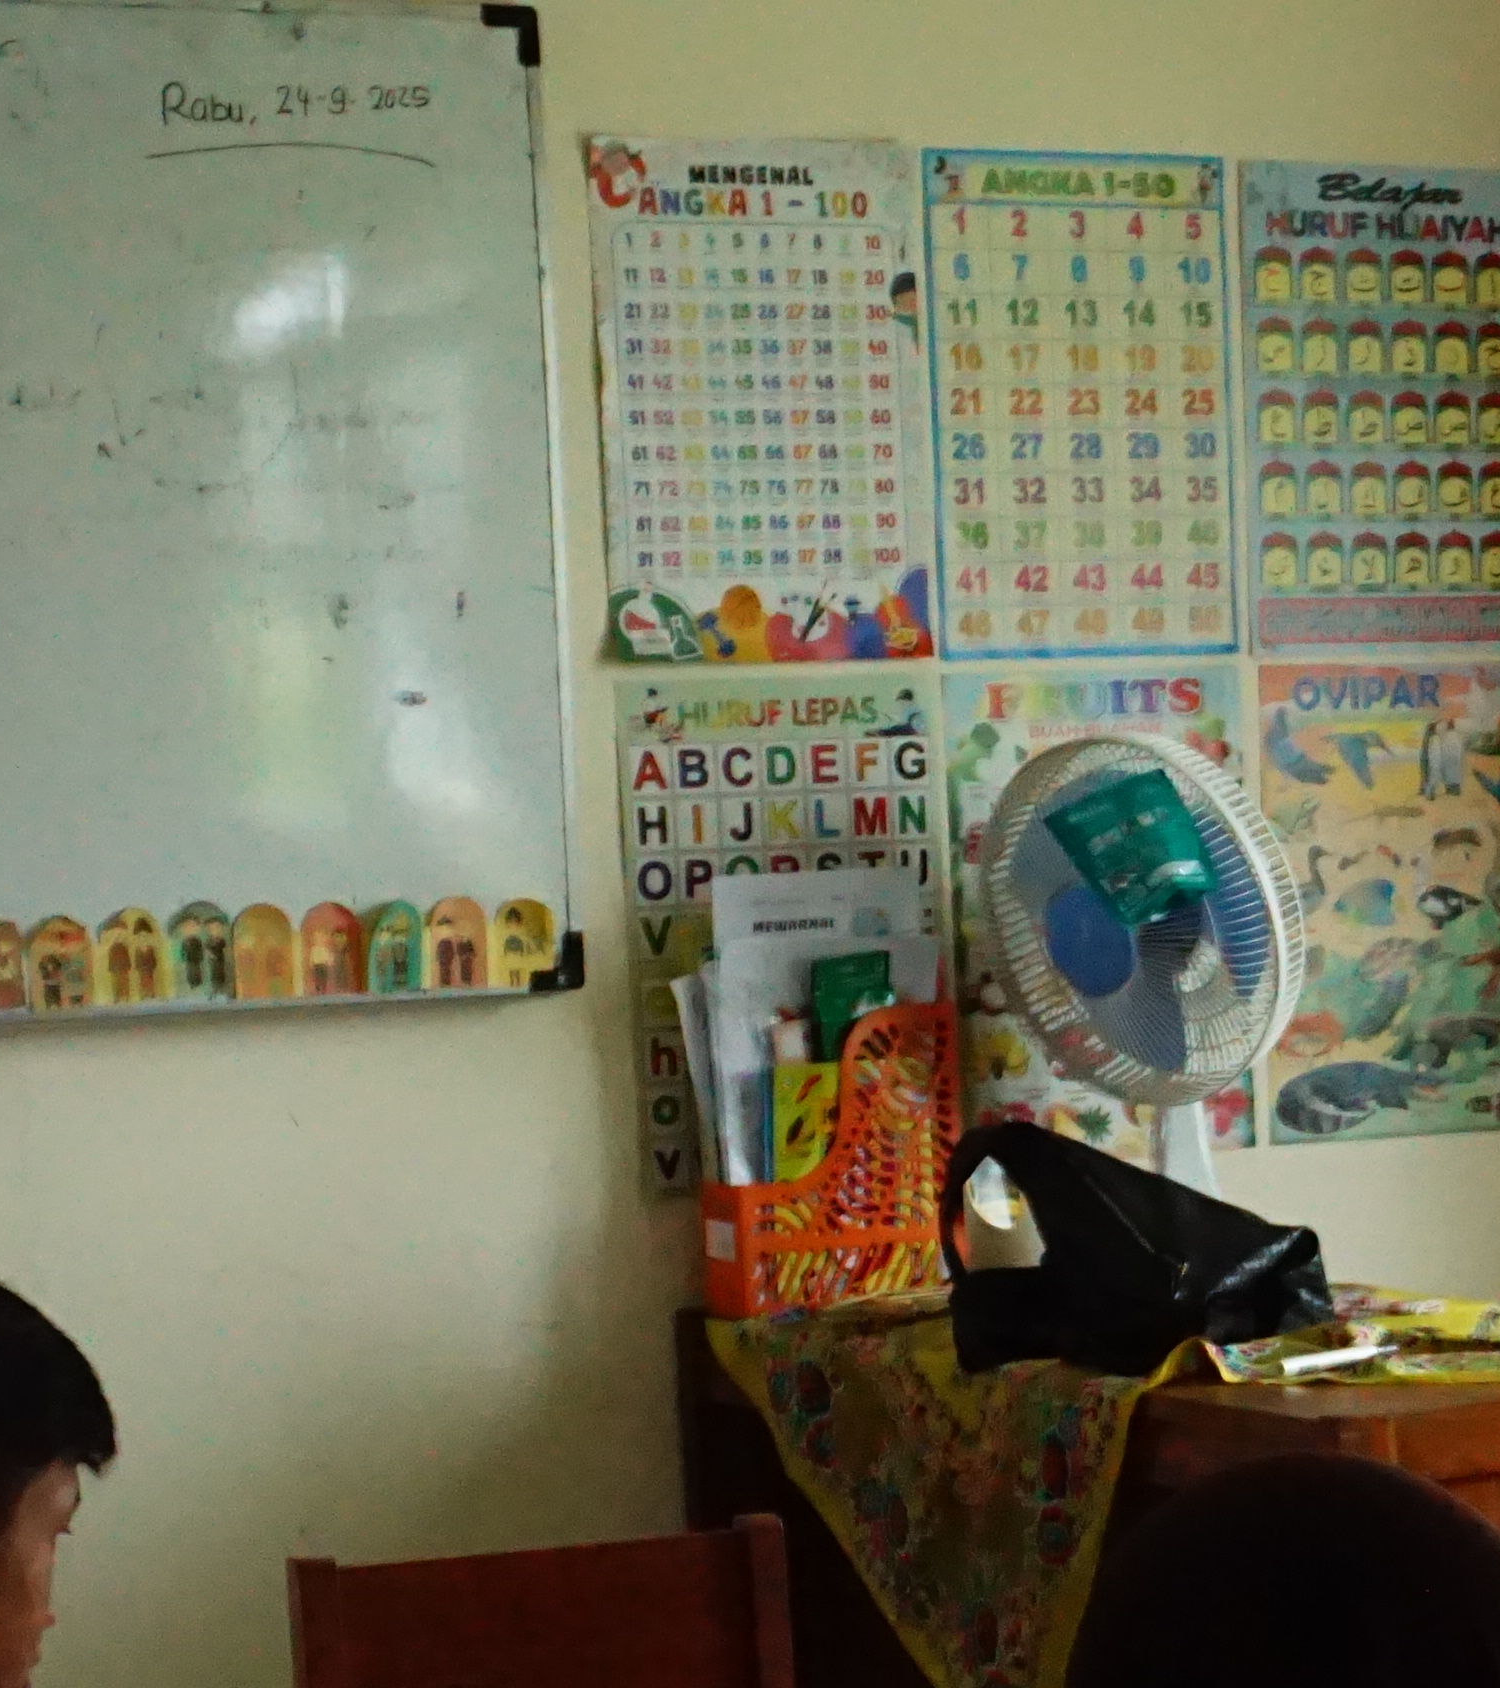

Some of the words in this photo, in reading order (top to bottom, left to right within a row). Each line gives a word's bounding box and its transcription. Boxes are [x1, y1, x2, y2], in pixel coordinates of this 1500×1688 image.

[161, 80, 257, 127] Rabu,
[689, 165, 813, 185] MENGENAL
[981, 168, 1095, 196] ANGKA
[638, 188, 747, 216] ANGKA
[761, 191, 774, 216] 1
[815, 191, 869, 218] 100
[1317, 172, 1463, 215] Belajar
[953, 206, 966, 235] 1
[1010, 209, 1027, 238] 2
[1070, 210, 1085, 239] 3
[1126, 212, 1144, 240] 4
[1185, 214, 1202, 240] 5
[1265, 210, 1369, 240] HURUF
[865, 269, 885, 285] 20
[1012, 254, 1029, 280] 7
[1178, 256, 1212, 285] 10
[625, 303, 641, 319] 21
[865, 304, 886, 320] 30
[948, 298, 978, 326] 11
[1006, 299, 1039, 326] 12
[1065, 299, 1098, 328] 13
[1123, 300, 1156, 328] 14
[1180, 301, 1212, 328] 15
[1010, 344, 1040, 371] 17
[950, 388, 982, 416] 21
[1010, 388, 1044, 416] 22
[1068, 388, 1100, 416] 23
[1125, 388, 1158, 416] 24
[1183, 388, 1215, 416] 25
[872, 444, 893, 460] 70
[952, 432, 986, 460] 26
[1010, 432, 1044, 460] 27
[1070, 432, 1102, 460] 28
[1184, 432, 1216, 459] 30
[954, 477, 984, 505] 31
[1012, 477, 1047, 504] 32
[1072, 476, 1104, 503] 33
[1130, 476, 1162, 502] 34
[1186, 476, 1218, 502] 35
[1014, 520, 1047, 548] 37
[874, 549, 901, 564] 100
[956, 564, 988, 594] 41
[1014, 564, 1049, 592] 42
[1073, 564, 1107, 592] 43
[1130, 563, 1163, 590] 44
[1186, 562, 1220, 589] 45
[985, 677, 1202, 720] FRUITS
[1292, 674, 1440, 710] OVIPAR
[677, 699, 781, 728] HURUF
[791, 696, 879, 726] LEPAS
[633, 750, 667, 791] A
[678, 749, 709, 788] B
[722, 747, 753, 786] C
[766, 746, 796, 785] D
[811, 744, 839, 784] E
[854, 743, 881, 782] F
[894, 741, 927, 781] G
[638, 806, 668, 846] H
[691, 804, 703, 844] I
[730, 802, 752, 842] J
[769, 800, 800, 838] K
[815, 798, 840, 838] L
[853, 797, 888, 836] M
[898, 796, 926, 834] N
[637, 860, 672, 901] O
[685, 859, 713, 898] P
[640, 915, 672, 956] V
[650, 1037, 678, 1077] h
